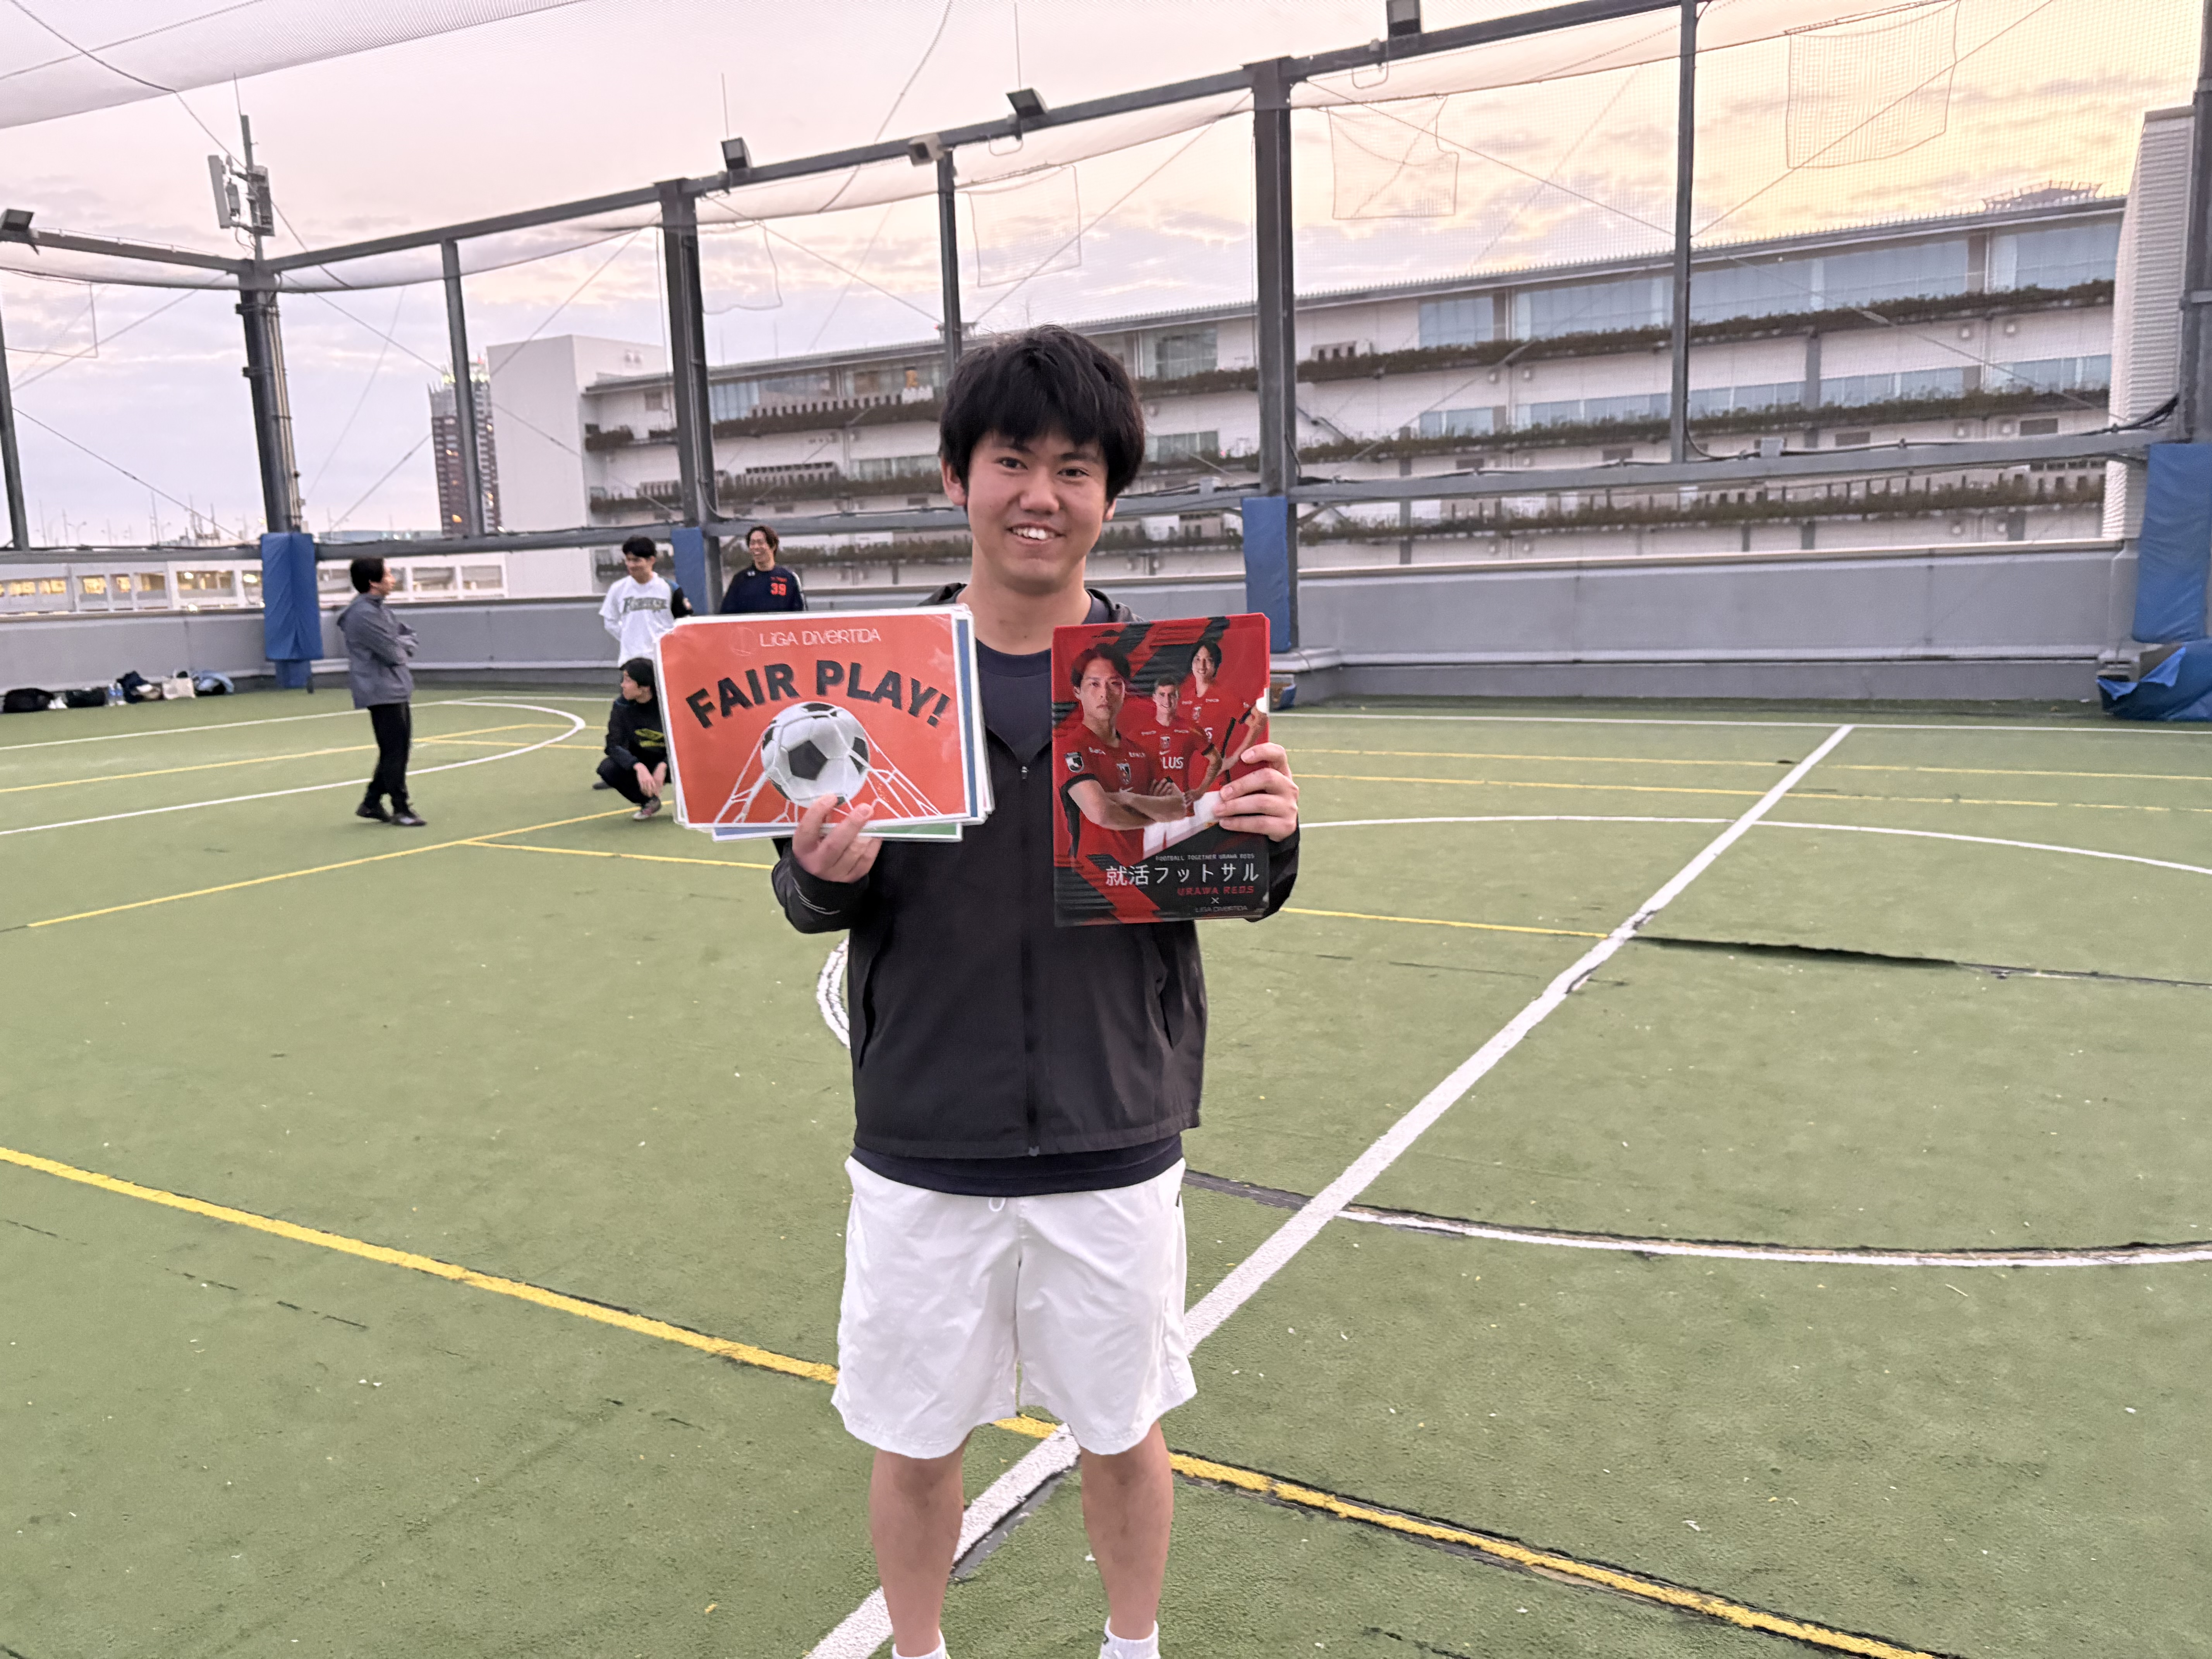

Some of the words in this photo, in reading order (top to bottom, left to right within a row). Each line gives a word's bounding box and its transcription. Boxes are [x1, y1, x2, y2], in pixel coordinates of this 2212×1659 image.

[770, 582, 787, 596] 39
[685, 663, 801, 729] FAIR
[816, 659, 951, 728] PLAY!
[1160, 756, 1184, 769] LUS
[1105, 862, 1259, 886] 就活フットサル
[1177, 886, 1219, 896] URAWA
[1223, 885, 1254, 895] REDS
